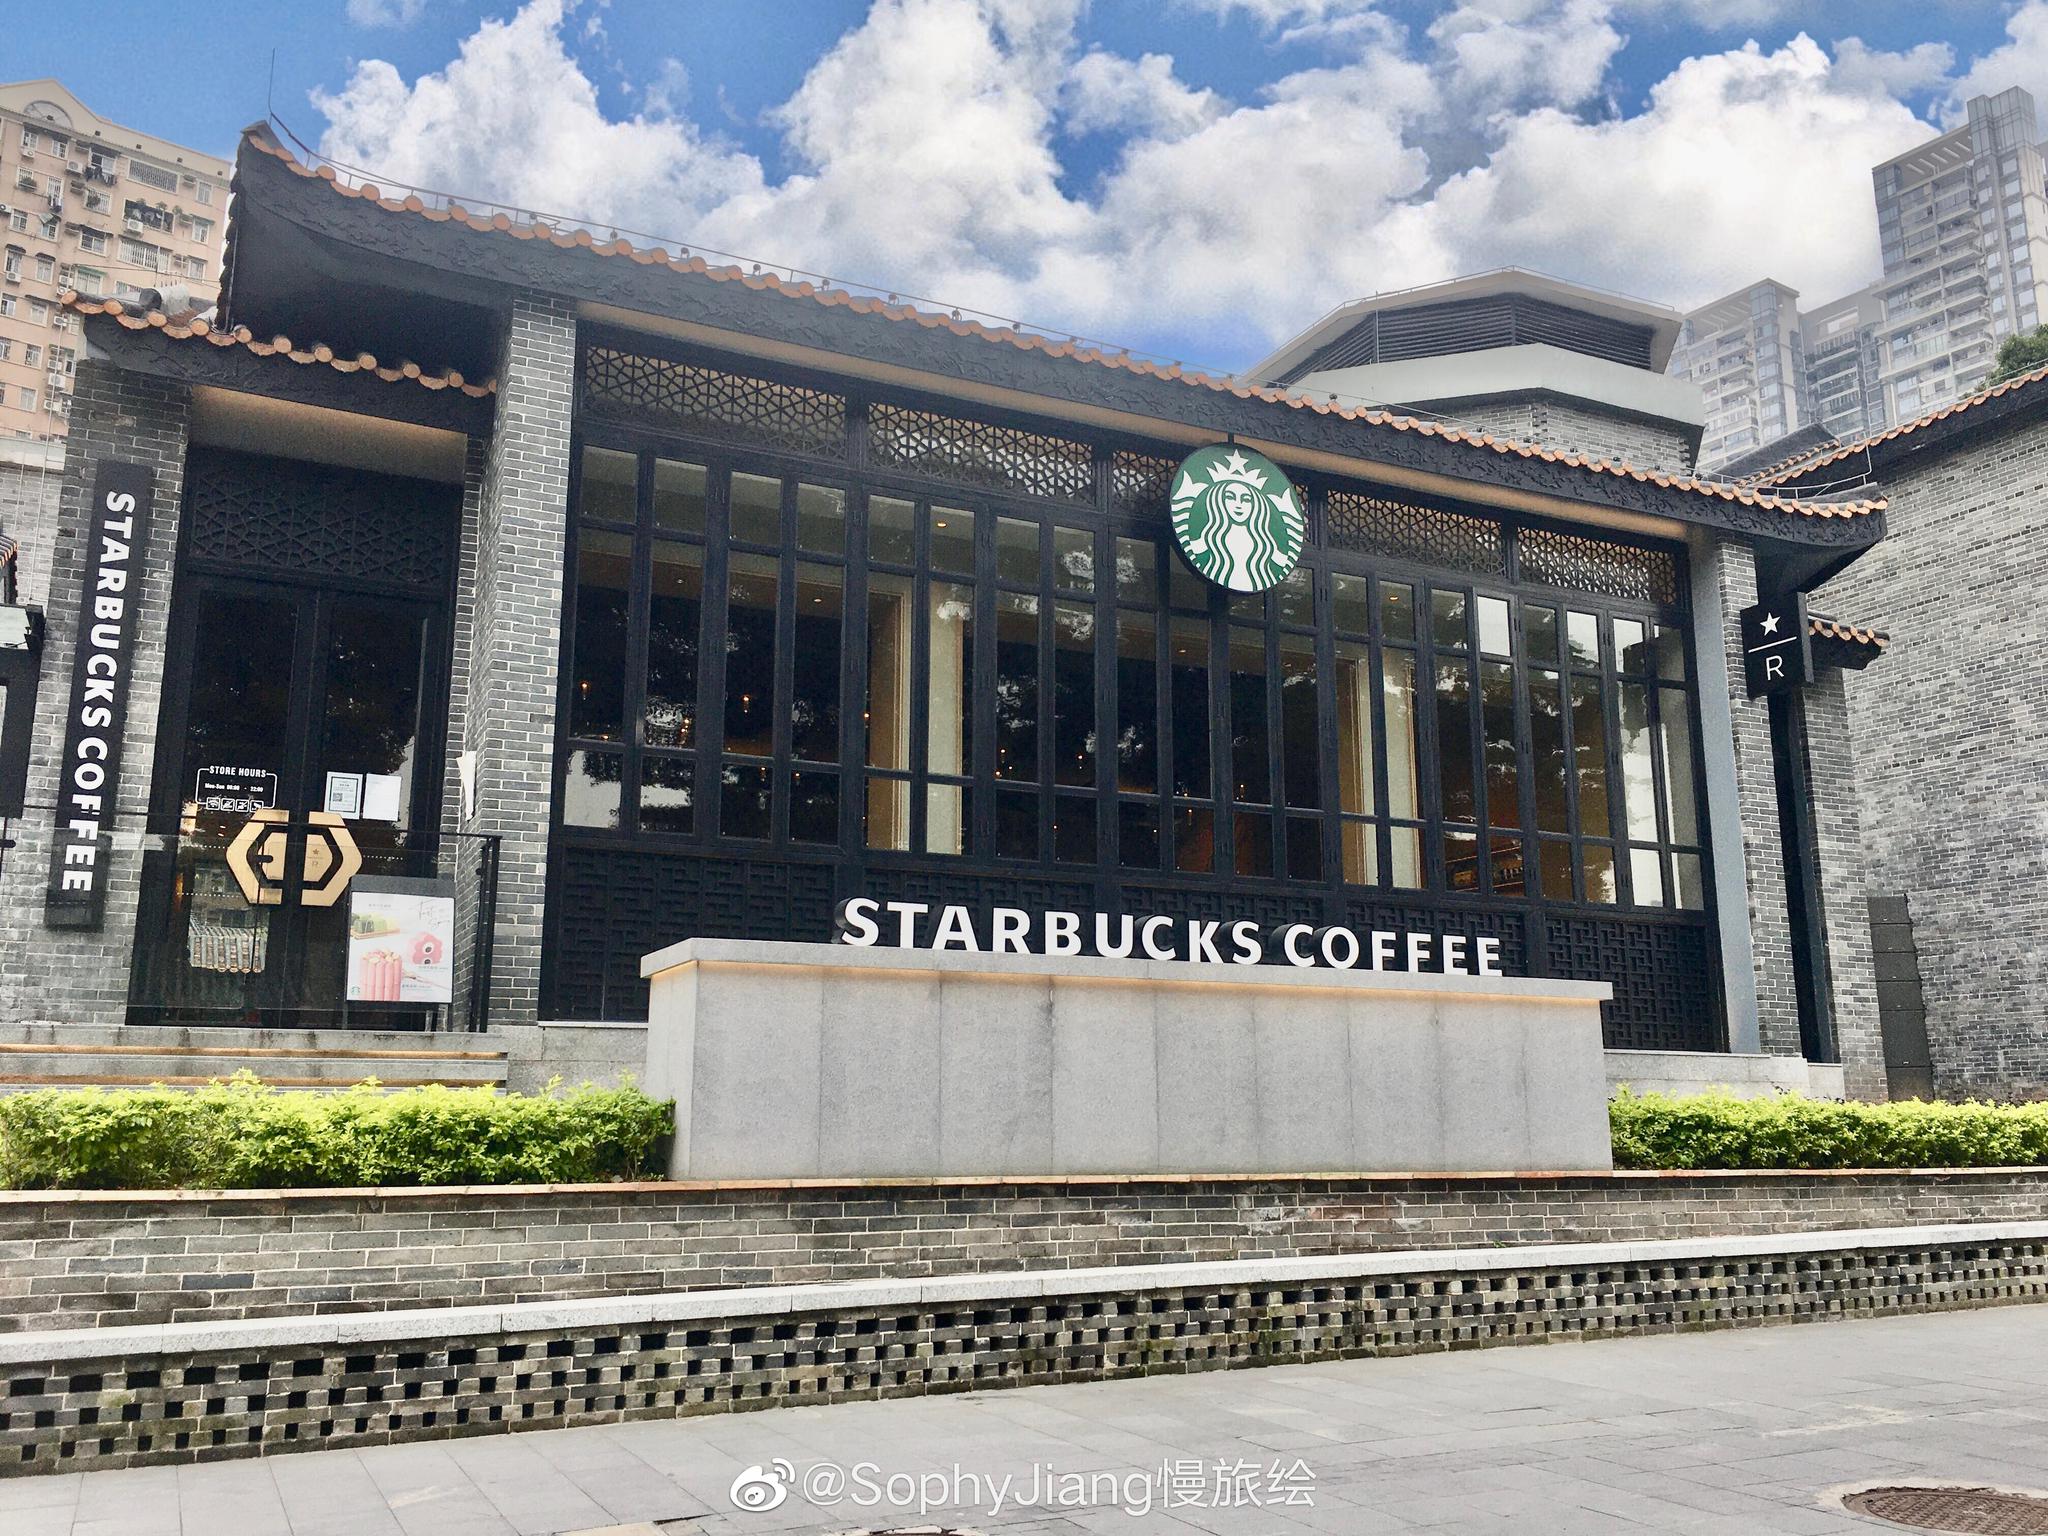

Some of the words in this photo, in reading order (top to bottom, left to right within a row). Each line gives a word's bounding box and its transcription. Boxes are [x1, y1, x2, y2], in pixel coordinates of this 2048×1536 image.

[81, 490, 136, 729] STARBUCKS
[1765, 655, 1785, 681] R
[209, 765, 236, 776] STORE
[238, 767, 267, 778] HOURS
[61, 737, 109, 891] COFFEE
[840, 897, 1263, 965] STARBUCKS
[1283, 922, 1503, 976] COFFEE
